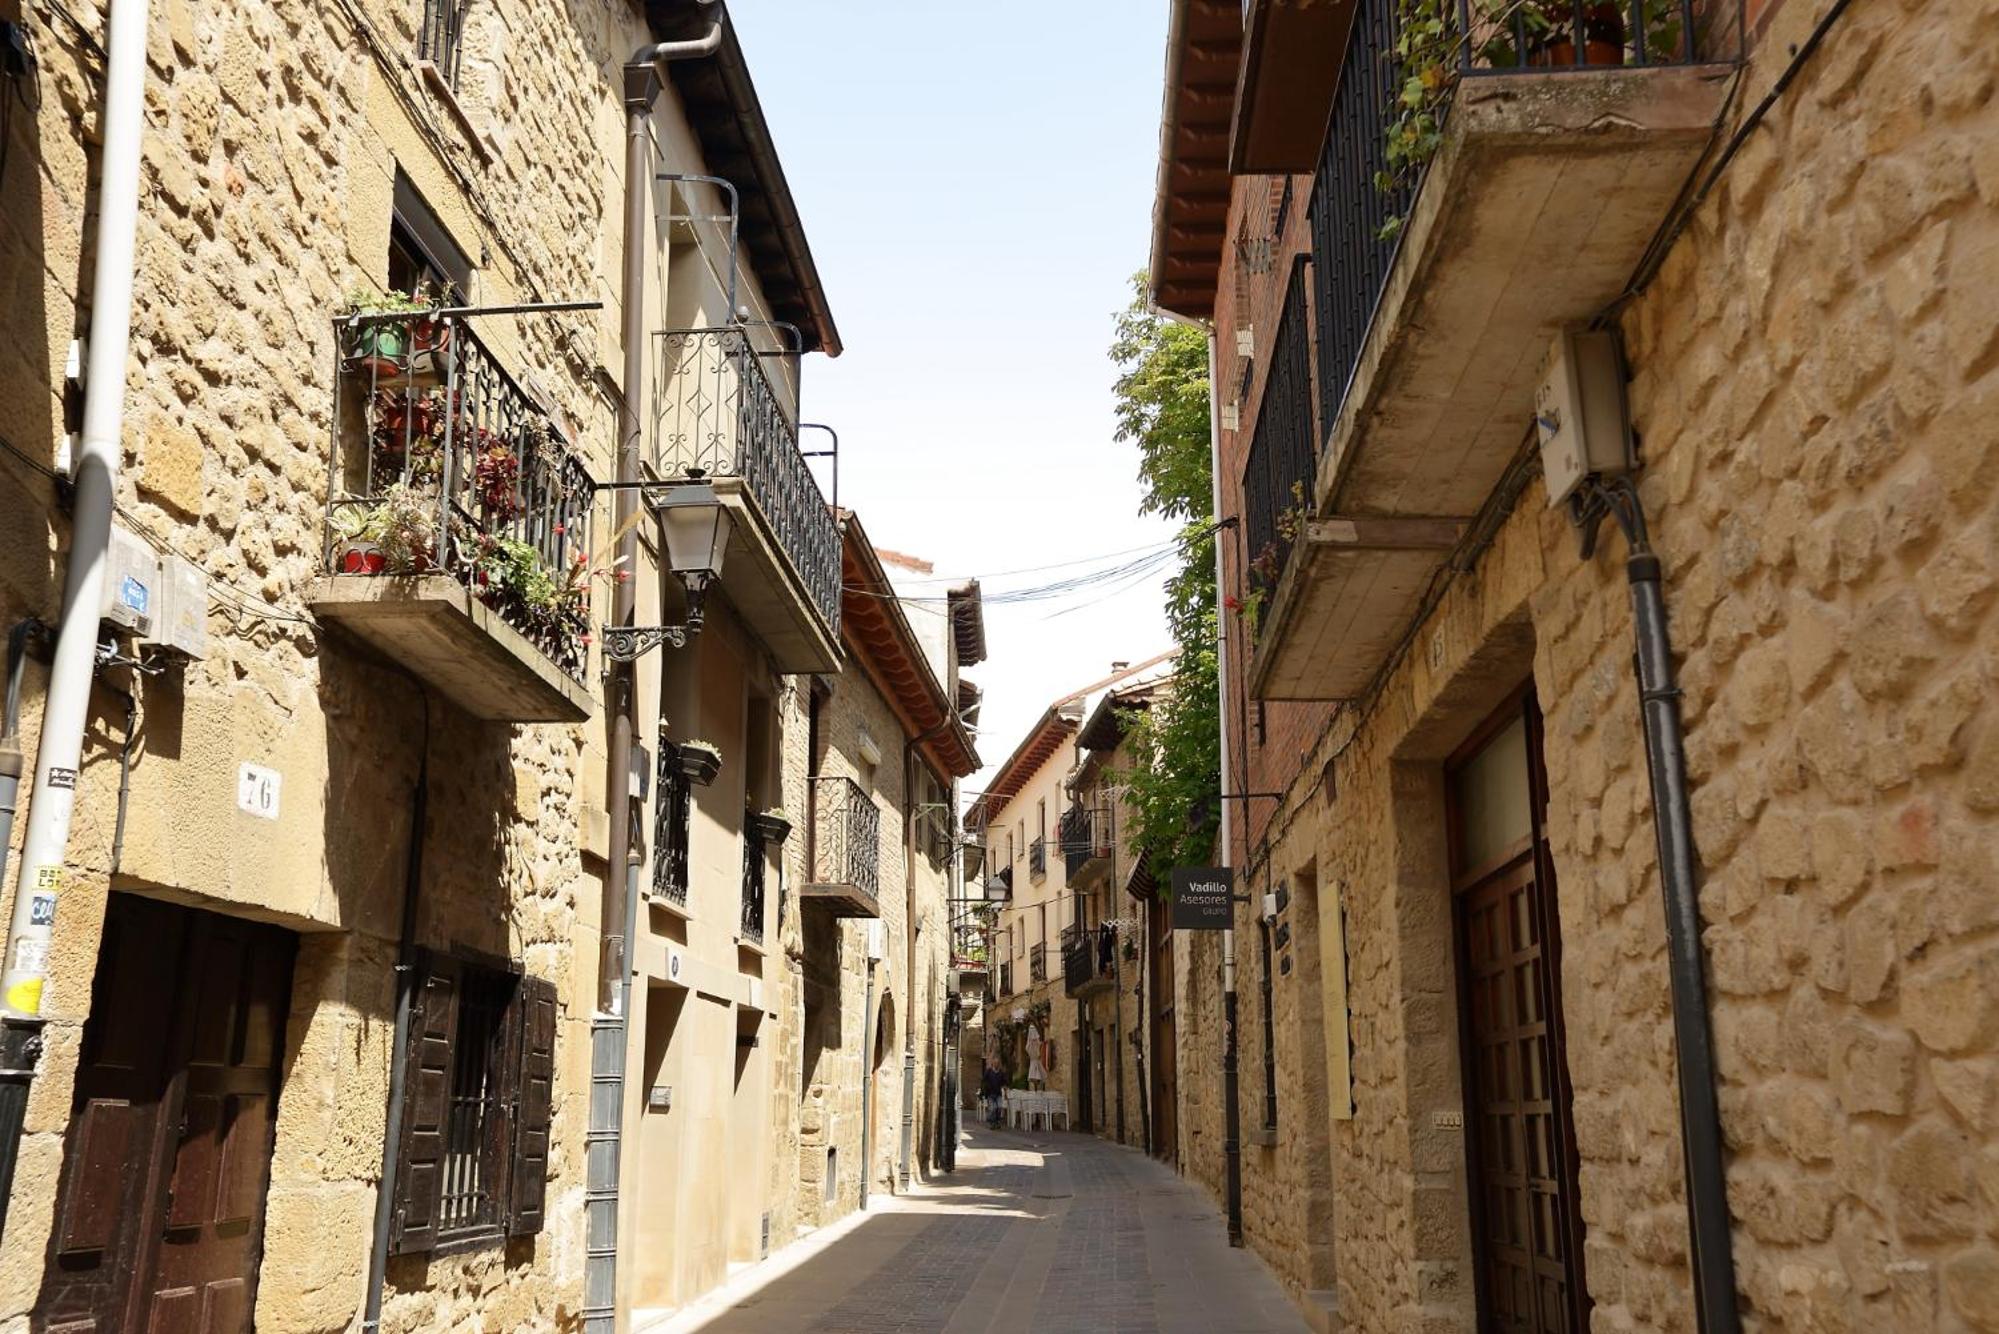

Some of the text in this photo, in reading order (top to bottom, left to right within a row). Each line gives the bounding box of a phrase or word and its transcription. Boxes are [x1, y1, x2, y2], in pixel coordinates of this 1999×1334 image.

[247, 772, 271, 810] 76
[1189, 881, 1227, 892] Vadillo
[1180, 894, 1227, 905] Asesores
